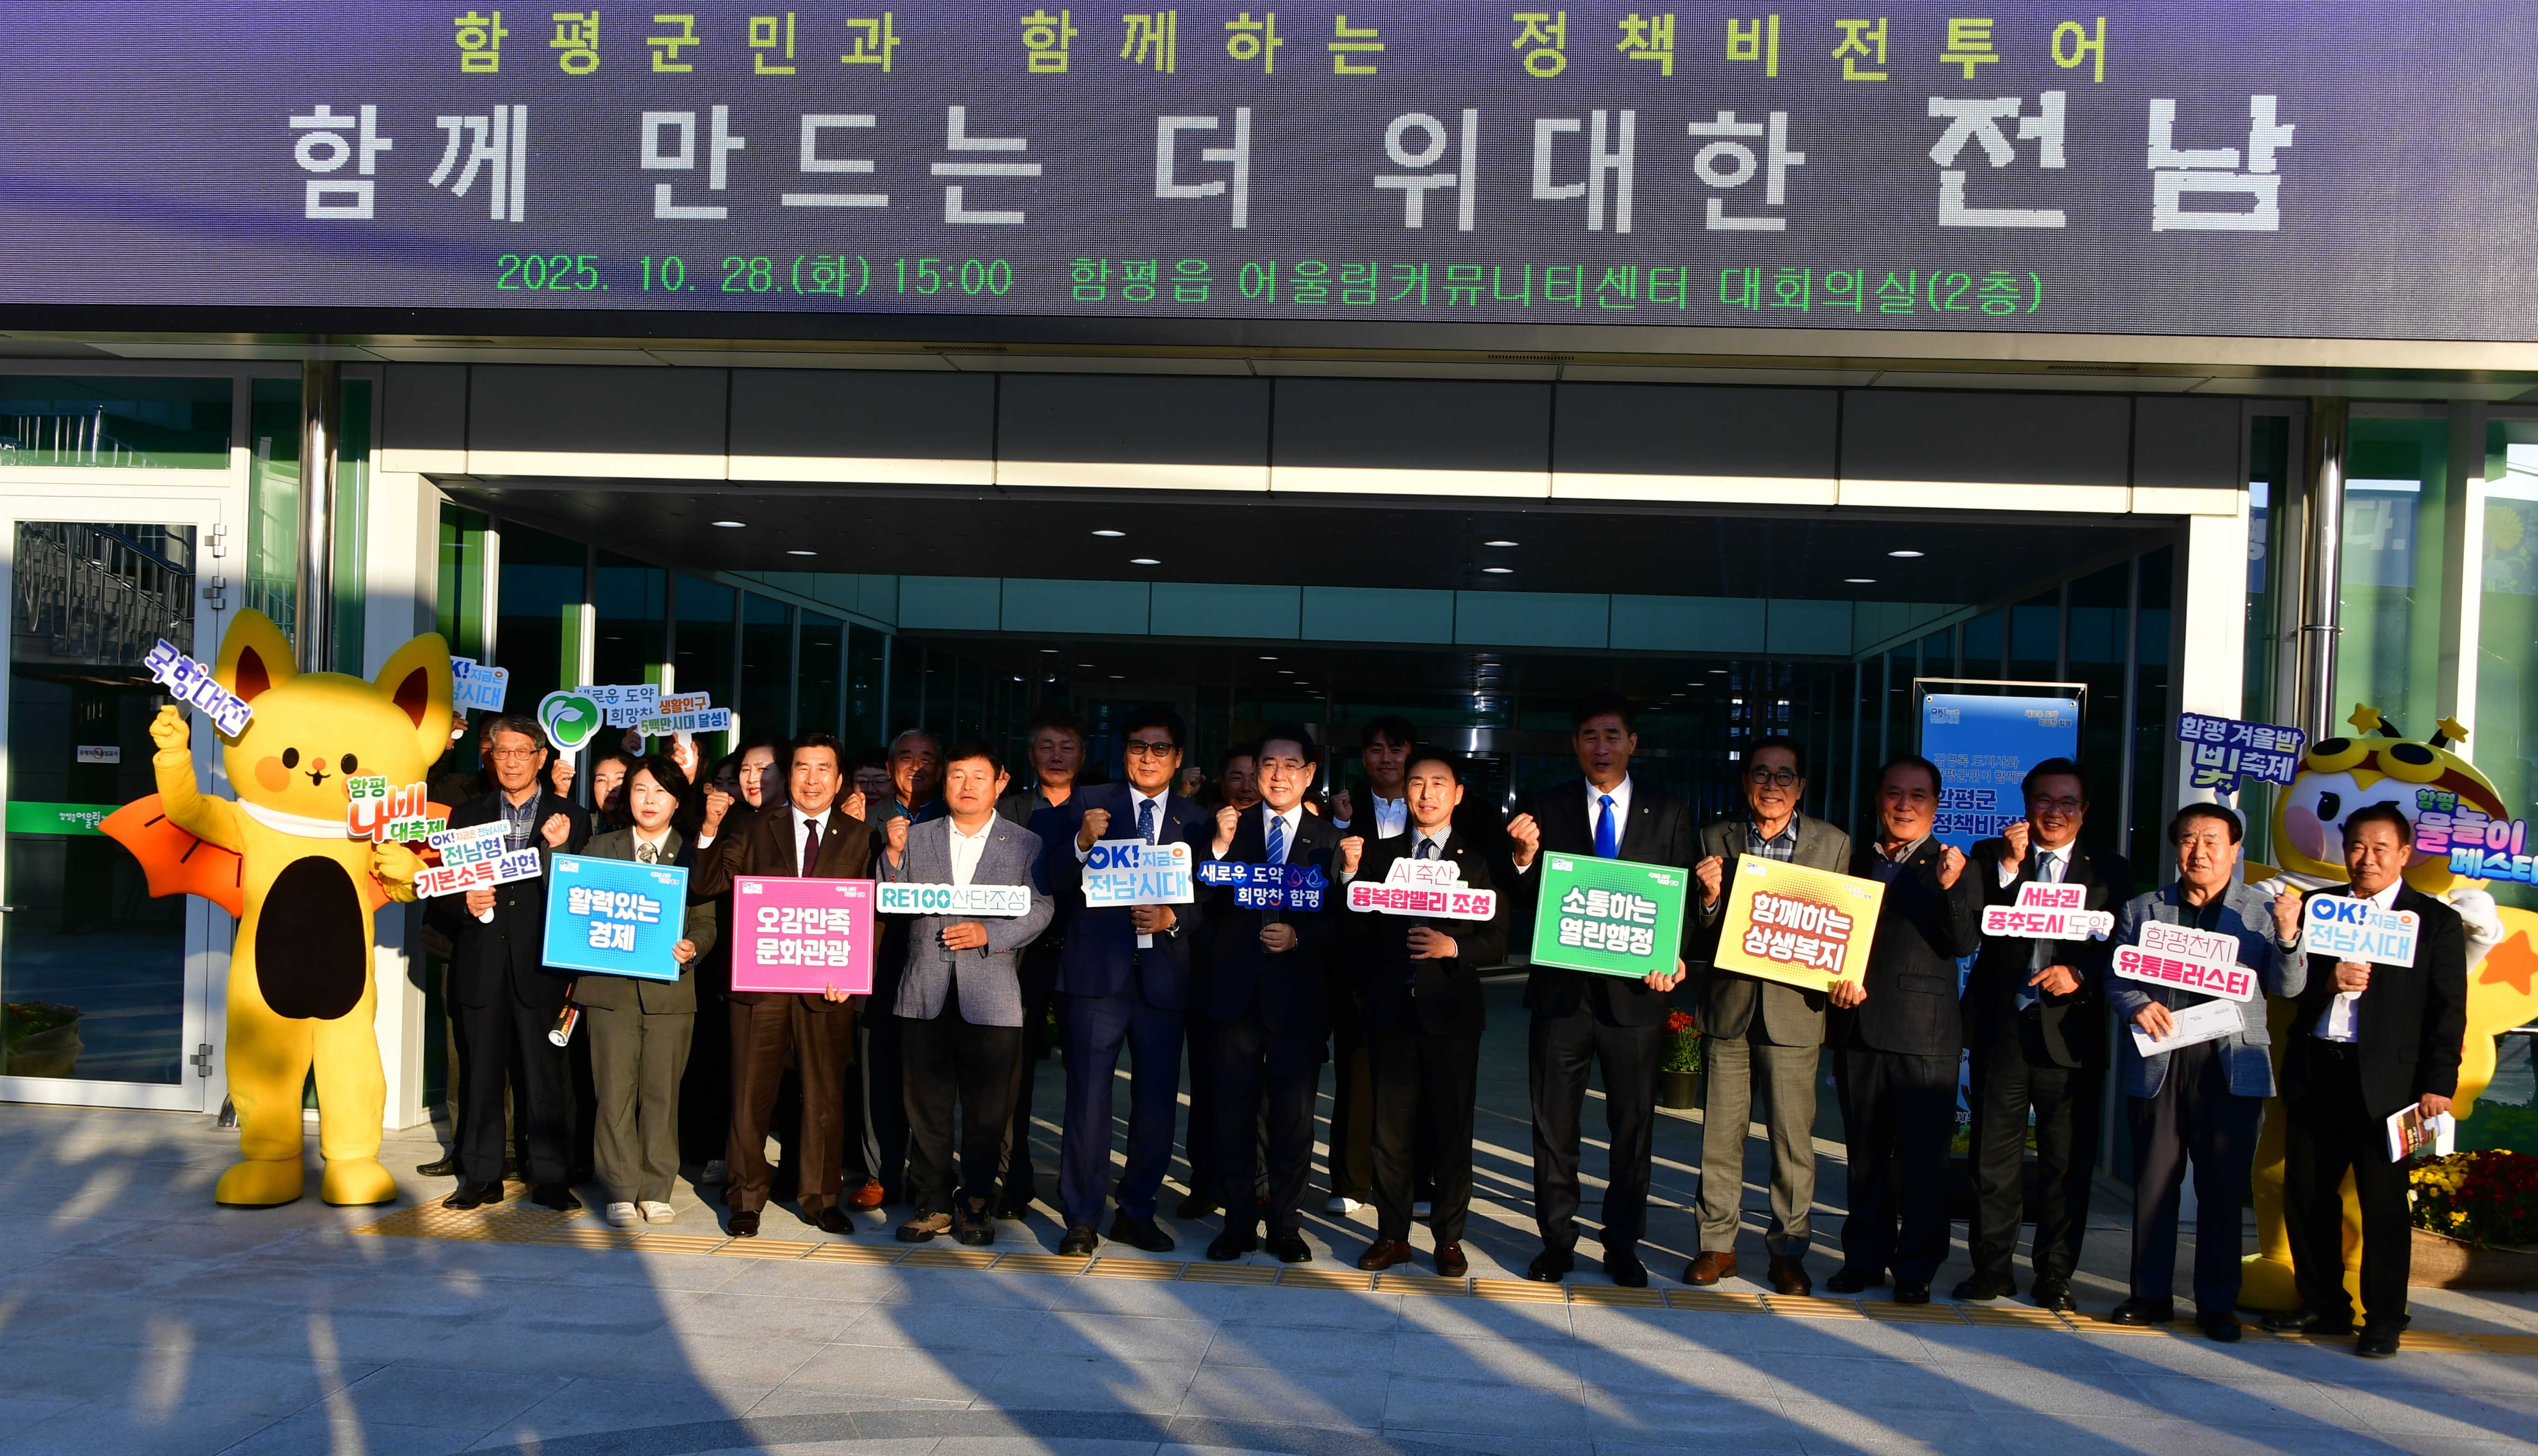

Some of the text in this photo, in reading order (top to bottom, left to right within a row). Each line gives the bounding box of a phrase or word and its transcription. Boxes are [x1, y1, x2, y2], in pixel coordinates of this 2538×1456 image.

[1023, 11, 1383, 73] 함께하는
[288, 90, 2296, 233] 함께 만드는 더 위대한 전남
[497, 253, 2042, 316] 2025. 10. 28.(화) 15:00 함평읍 어울림커뮤니티센터 대회의실(2층)
[451, 659, 504, 685] K! 지금은
[146, 640, 251, 735] 국향대전
[579, 688, 654, 704] 로운 도약
[659, 696, 706, 715] 생활인구
[641, 711, 727, 733] 5백만시대 달성!
[2181, 717, 2301, 753] 함평 겨울밤
[1935, 753, 2019, 768] 김영록 도지사와
[349, 777, 385, 798] 함평
[1939, 788, 1996, 811] 함평군
[2418, 790, 2456, 810] 함평
[350, 783, 425, 842] 나비
[1933, 813, 2027, 836] 정책비전
[391, 819, 445, 841] 대축제
[432, 823, 508, 846] OK! 지금은 전남시대
[2415, 805, 2525, 855] 물놀이
[444, 837, 502, 867] 전남형
[1087, 844, 1186, 870] OK! 지금은
[419, 852, 538, 894] 기본소득 실현
[1088, 871, 1187, 901] 전남시대
[1201, 864, 1284, 884] 새로운 도약
[1391, 863, 1455, 886] AI 축산
[568, 888, 660, 923] 활력있는
[1290, 888, 1320, 908] 함평
[1352, 887, 1490, 915] 융복합밸리 조성
[1562, 887, 1657, 924] 소통하는
[2022, 887, 2080, 908] 서남권
[756, 907, 851, 936] 오감만족
[1752, 895, 1851, 939] 함께하는
[1987, 911, 2108, 936] 중추도시 도약
[2312, 898, 2412, 932] OK! 지금은
[589, 921, 634, 952] 경제
[1559, 918, 1654, 956] 열린행정
[1745, 925, 1845, 972] 상생복지
[2145, 926, 2232, 963] 함평천지
[2309, 924, 2410, 960] 전남시대
[756, 937, 851, 967] 문화관광
[2119, 951, 2250, 996] 유통클러스터
